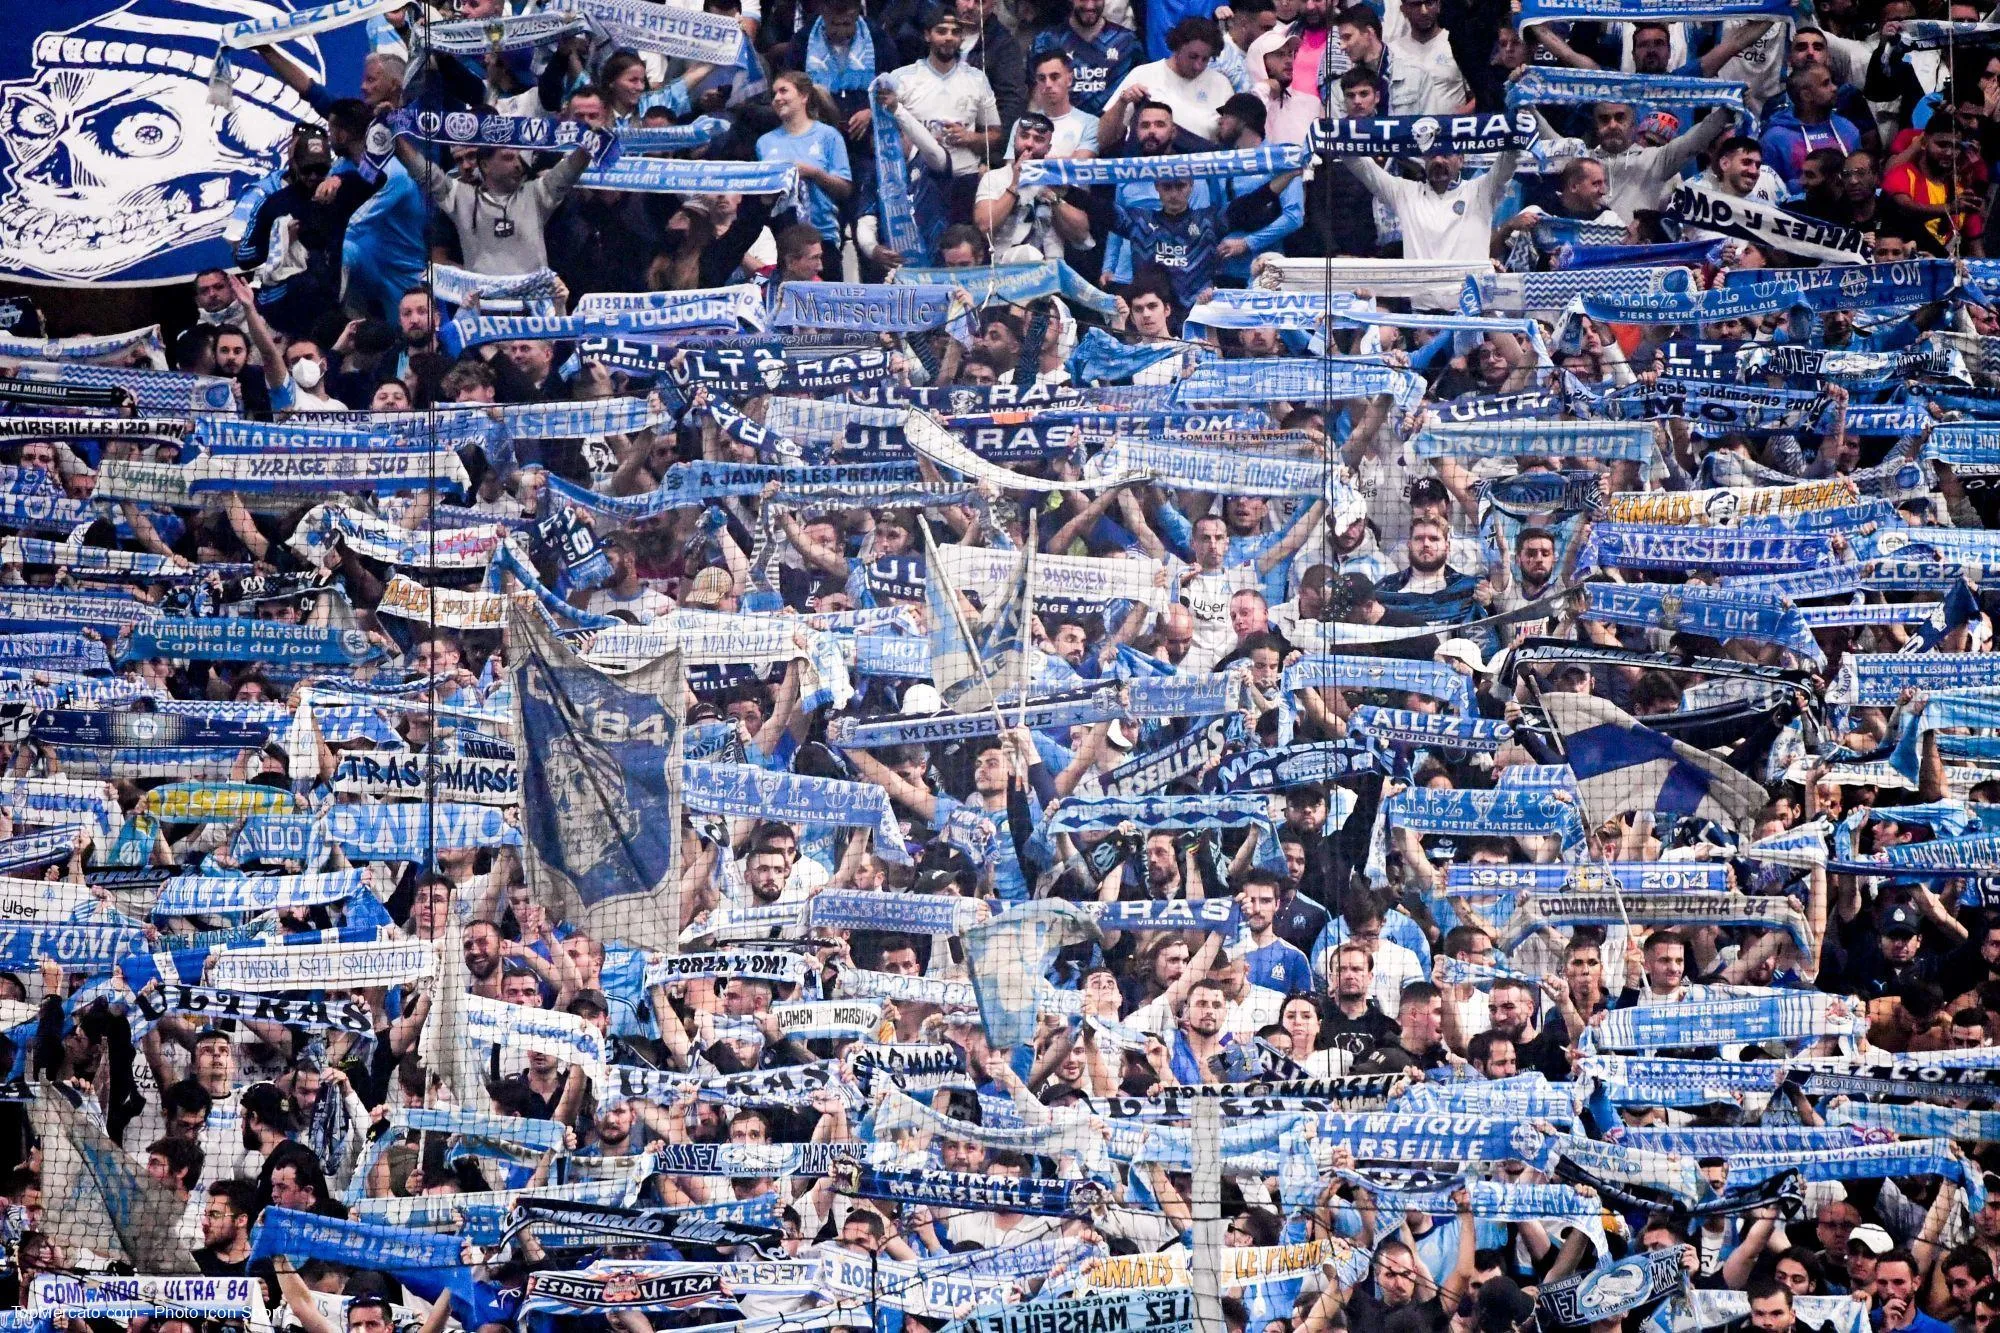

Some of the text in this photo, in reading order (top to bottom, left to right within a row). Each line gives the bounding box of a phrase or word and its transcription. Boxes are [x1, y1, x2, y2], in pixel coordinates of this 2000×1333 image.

[233, 4, 328, 38] ALLEZ
[1073, 66, 1108, 81] Uber
[1072, 80, 1107, 93] Eats
[1546, 80, 1622, 98] ULTRAS
[1315, 138, 1506, 152] MARSEILLE VIRAGE
[1074, 160, 1257, 181] DE MARSEILLE
[1155, 242, 1188, 256] Uber
[1154, 254, 1189, 267] Eats
[831, 288, 868, 297] ALLEZ
[630, 298, 738, 328] TOUJOURS
[791, 288, 933, 327] Marseille
[1619, 311, 1652, 320] FIERS
[1658, 309, 1696, 320] D'ETRE
[1700, 300, 1778, 318] MARSEILLAIS
[461, 316, 583, 341] PARTOUT
[582, 353, 666, 371] MARSEILLE
[799, 368, 884, 388] VIRAGE SUD
[24, 385, 68, 397] MARSEILLE
[0, 420, 150, 436] MARSEILLE 120
[1179, 433, 1225, 442] SOMMES
[1434, 434, 1636, 454] DROIT AU BUT
[250, 456, 409, 476] VIRAGE SUD
[719, 468, 797, 488] JAMAIS
[800, 468, 828, 483] LES
[1620, 533, 1798, 562] MARSEILLE
[1075, 602, 1105, 614] SUD
[1193, 597, 1225, 613] Uber
[137, 620, 329, 640] Olympique de Marseille
[155, 640, 323, 657] Capitale du foot
[702, 634, 784, 653] MARSEILLE
[1911, 664, 1922, 675] NE
[1923, 663, 1958, 675] CESSERA
[1960, 662, 1991, 674] JAMAIS
[592, 709, 668, 747] 84
[1371, 708, 1464, 737] ALLEZ
[1368, 726, 1444, 744] OLYMPIQUE
[1447, 738, 1460, 747] DE
[1507, 764, 1564, 786] ALLEZ
[685, 793, 847, 820] FIERS D'ETRE MARSEILLAIS
[1403, 817, 1437, 829] FIERS
[1441, 819, 1479, 831] D'ETRE
[1892, 838, 1991, 866] LA PASSION PLUS
[1470, 869, 1709, 889] 1984 2014
[2, 898, 40, 919] Uber
[1538, 897, 1647, 917] COMMANDO
[1743, 898, 1769, 916] 84
[667, 953, 788, 976] FORZA L'OM!
[134, 984, 372, 1033] ULTRAS
[1713, 1001, 1761, 1014] MARSEILLE
[1322, 1115, 1492, 1137] LYMPIQUE
[655, 1143, 723, 1171] ALLEZ
[227, 1279, 249, 1301] 84
[535, 1277, 604, 1300] ESPRIT
[841, 1262, 1002, 1307] ROBERT PIRES
